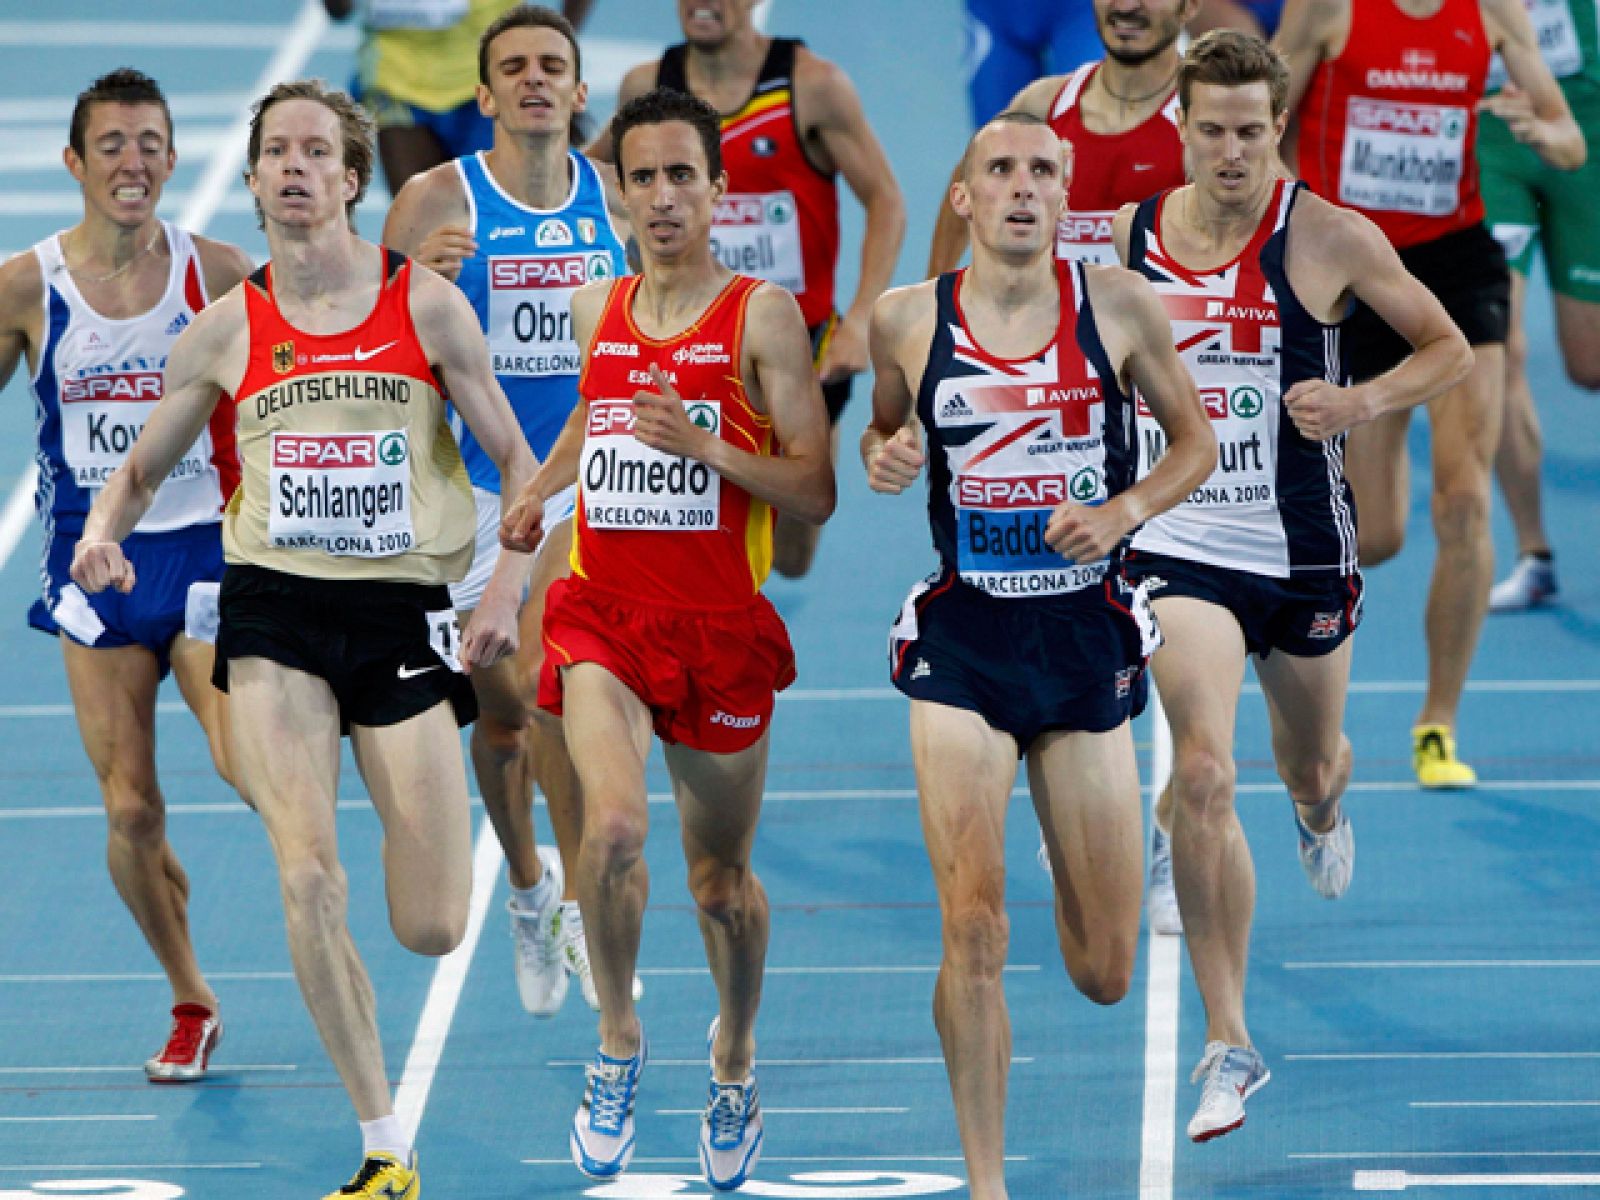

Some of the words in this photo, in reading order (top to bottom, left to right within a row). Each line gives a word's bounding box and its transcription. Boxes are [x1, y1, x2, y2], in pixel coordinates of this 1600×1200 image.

[494, 260, 584, 286] SPAR
[1226, 305, 1277, 321] AVIVA
[64, 377, 161, 400] SPAR
[256, 373, 411, 419] DEUTSCHLAND
[1050, 387, 1099, 403] AVIVA
[276, 439, 373, 464] SPAR
[586, 447, 709, 496] Olmedo
[280, 472, 404, 528] Schlangen
[961, 478, 1065, 504] SPAR
[1235, 484, 1271, 503] 2010
[679, 508, 714, 526] 2010
[376, 530, 411, 551] 2010
